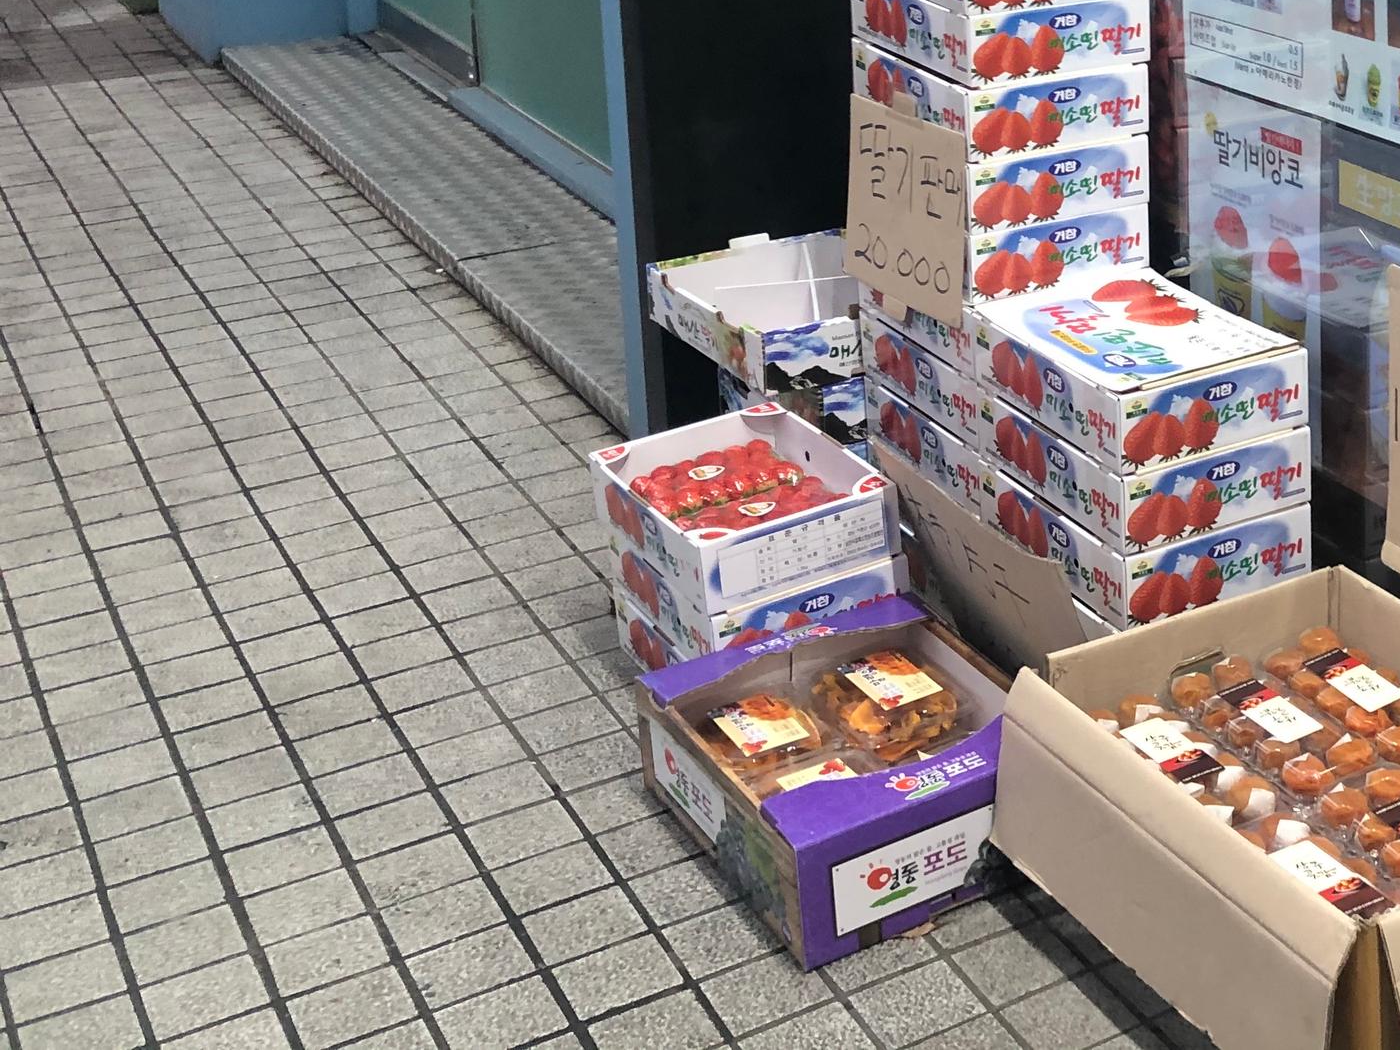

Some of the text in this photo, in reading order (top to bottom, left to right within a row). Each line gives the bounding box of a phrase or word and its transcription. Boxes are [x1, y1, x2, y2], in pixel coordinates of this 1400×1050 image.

[1100, 23, 1141, 55] 딸기
[1100, 95, 1140, 127] 딸기
[1214, 130, 1303, 188] 딸기비앙코
[1100, 166, 1140, 199] 딸기
[1100, 232, 1140, 266] 딸기
[1257, 384, 1299, 422] 딸기
[1088, 409, 1116, 448] 딸기
[1260, 462, 1302, 500] 딸기
[1091, 488, 1119, 528] 딸기
[1260, 538, 1302, 577] 딸기
[1093, 566, 1121, 606] 딸기
[943, 754, 987, 778] 포도
[924, 841, 968, 876] 포도
